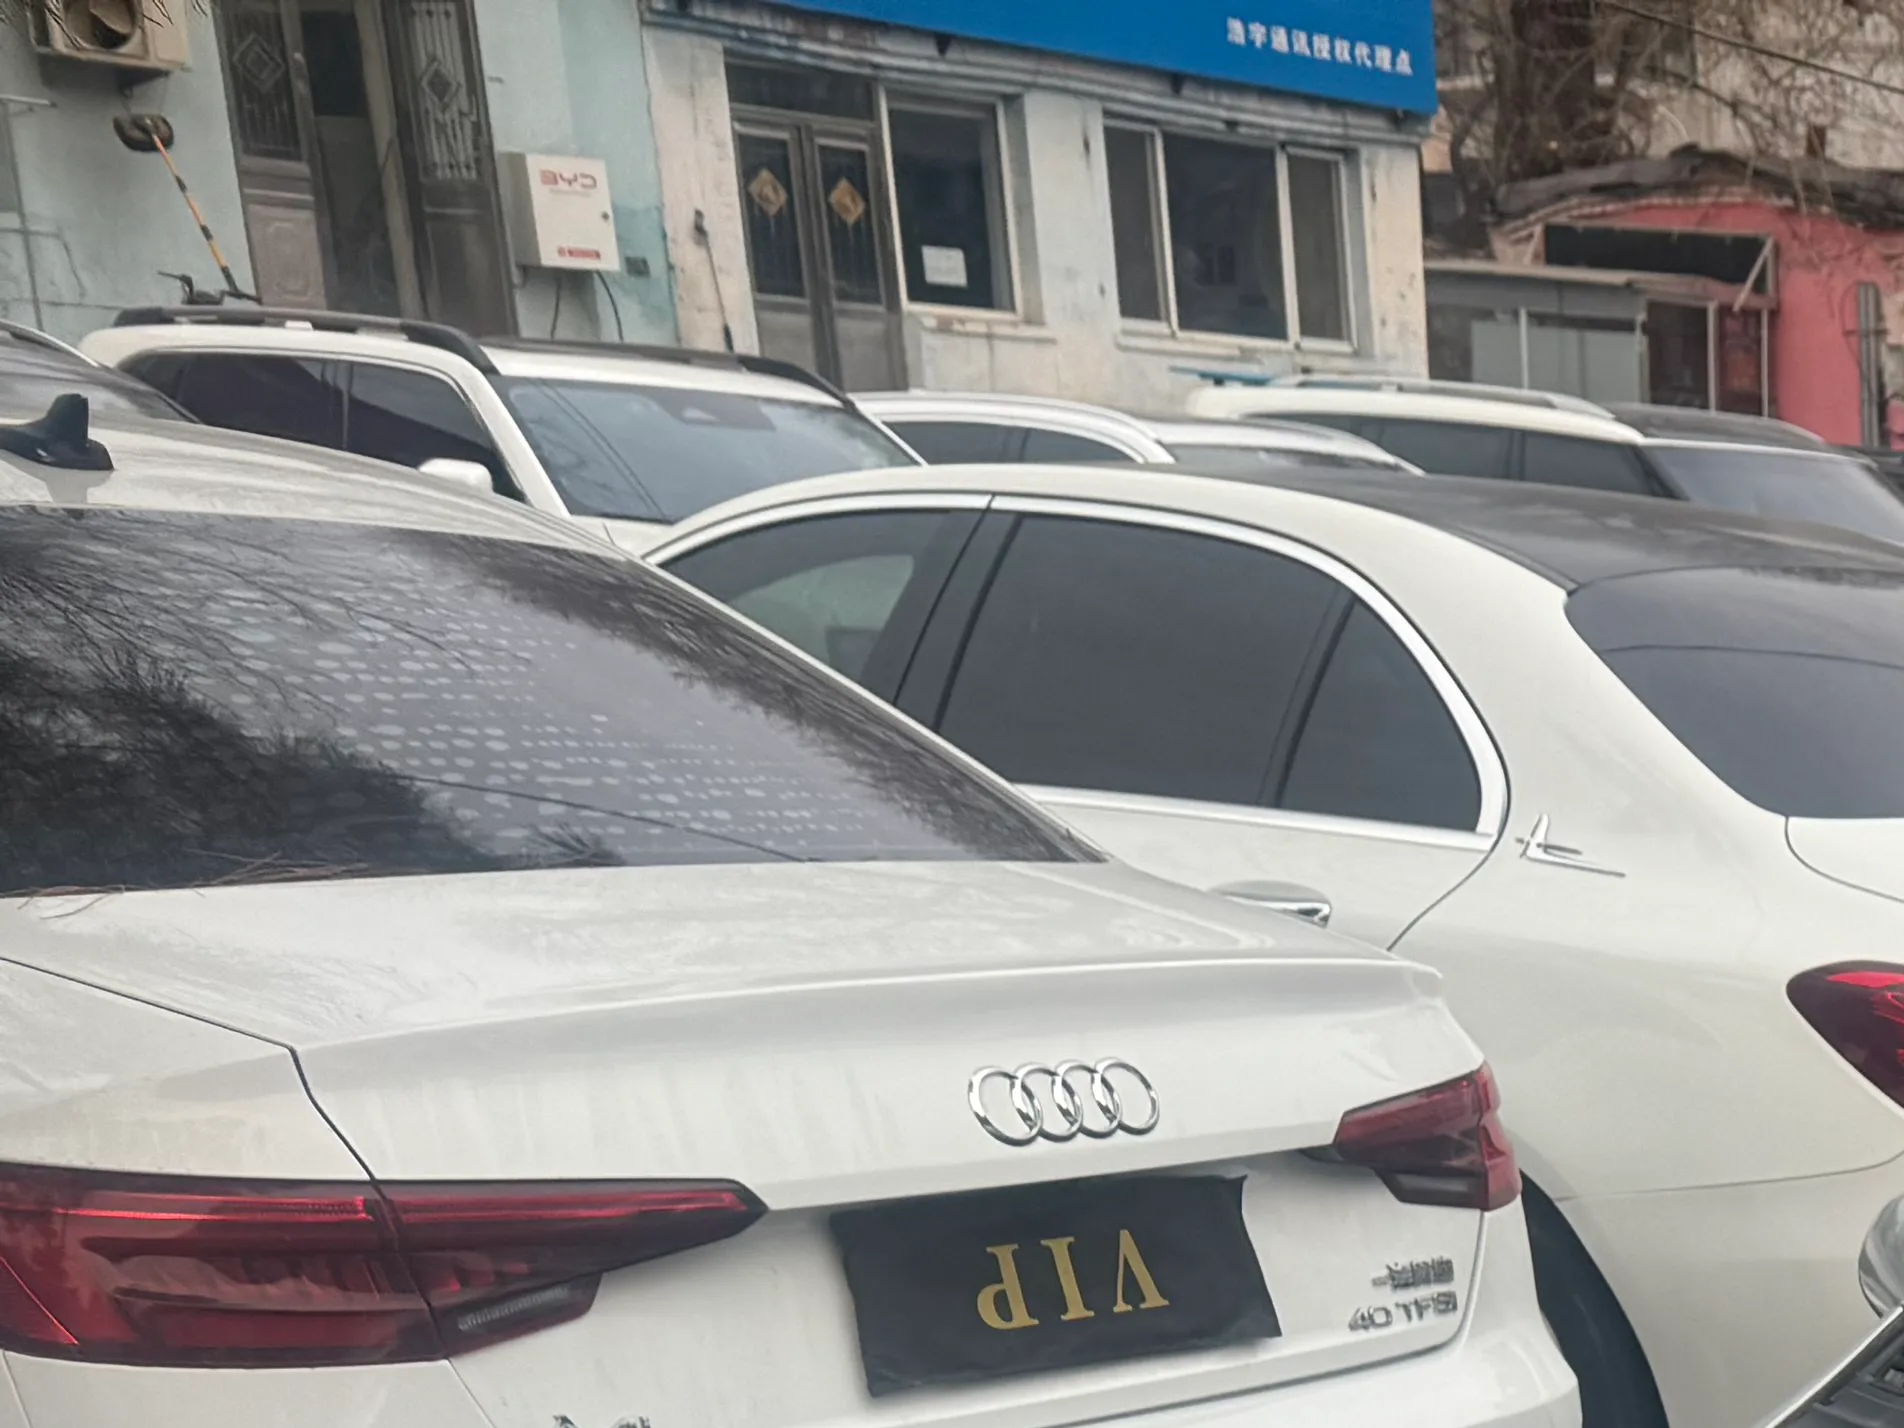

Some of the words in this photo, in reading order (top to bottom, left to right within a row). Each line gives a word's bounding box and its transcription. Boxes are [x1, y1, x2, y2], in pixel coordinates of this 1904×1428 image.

[540, 169, 597, 190] BYD
[976, 1229, 1170, 1330] VIP
[1348, 1306, 1394, 1332] 40
[1395, 1290, 1458, 1323] TFSI
